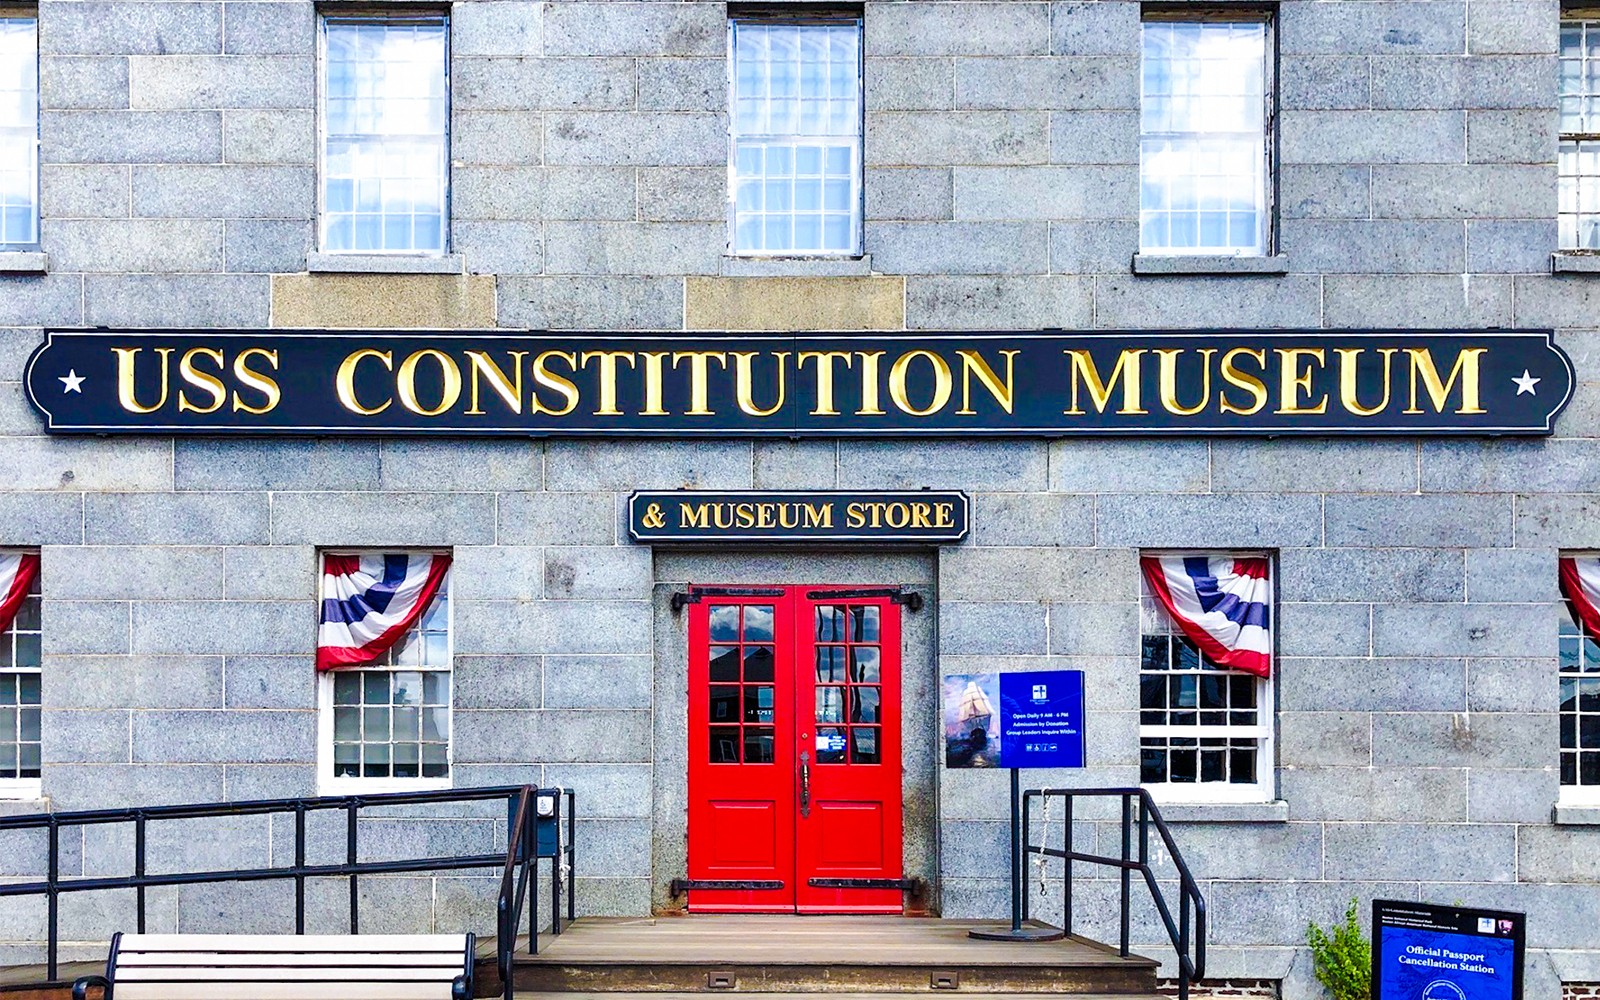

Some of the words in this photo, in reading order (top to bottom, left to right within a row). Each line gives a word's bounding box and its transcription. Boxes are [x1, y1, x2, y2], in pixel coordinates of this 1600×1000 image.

[111, 347, 281, 415] USS
[335, 349, 1020, 416] CONSTITUTION
[1063, 347, 1488, 416] MUSEUM
[642, 502, 666, 529] &
[679, 503, 833, 529] MUSEUM
[846, 502, 955, 529] STORE
[1398, 955, 1458, 970] Cancellation
[1459, 962, 1495, 974] Station
[1406, 945, 1440, 957] Official
[1442, 949, 1485, 962] Passport
